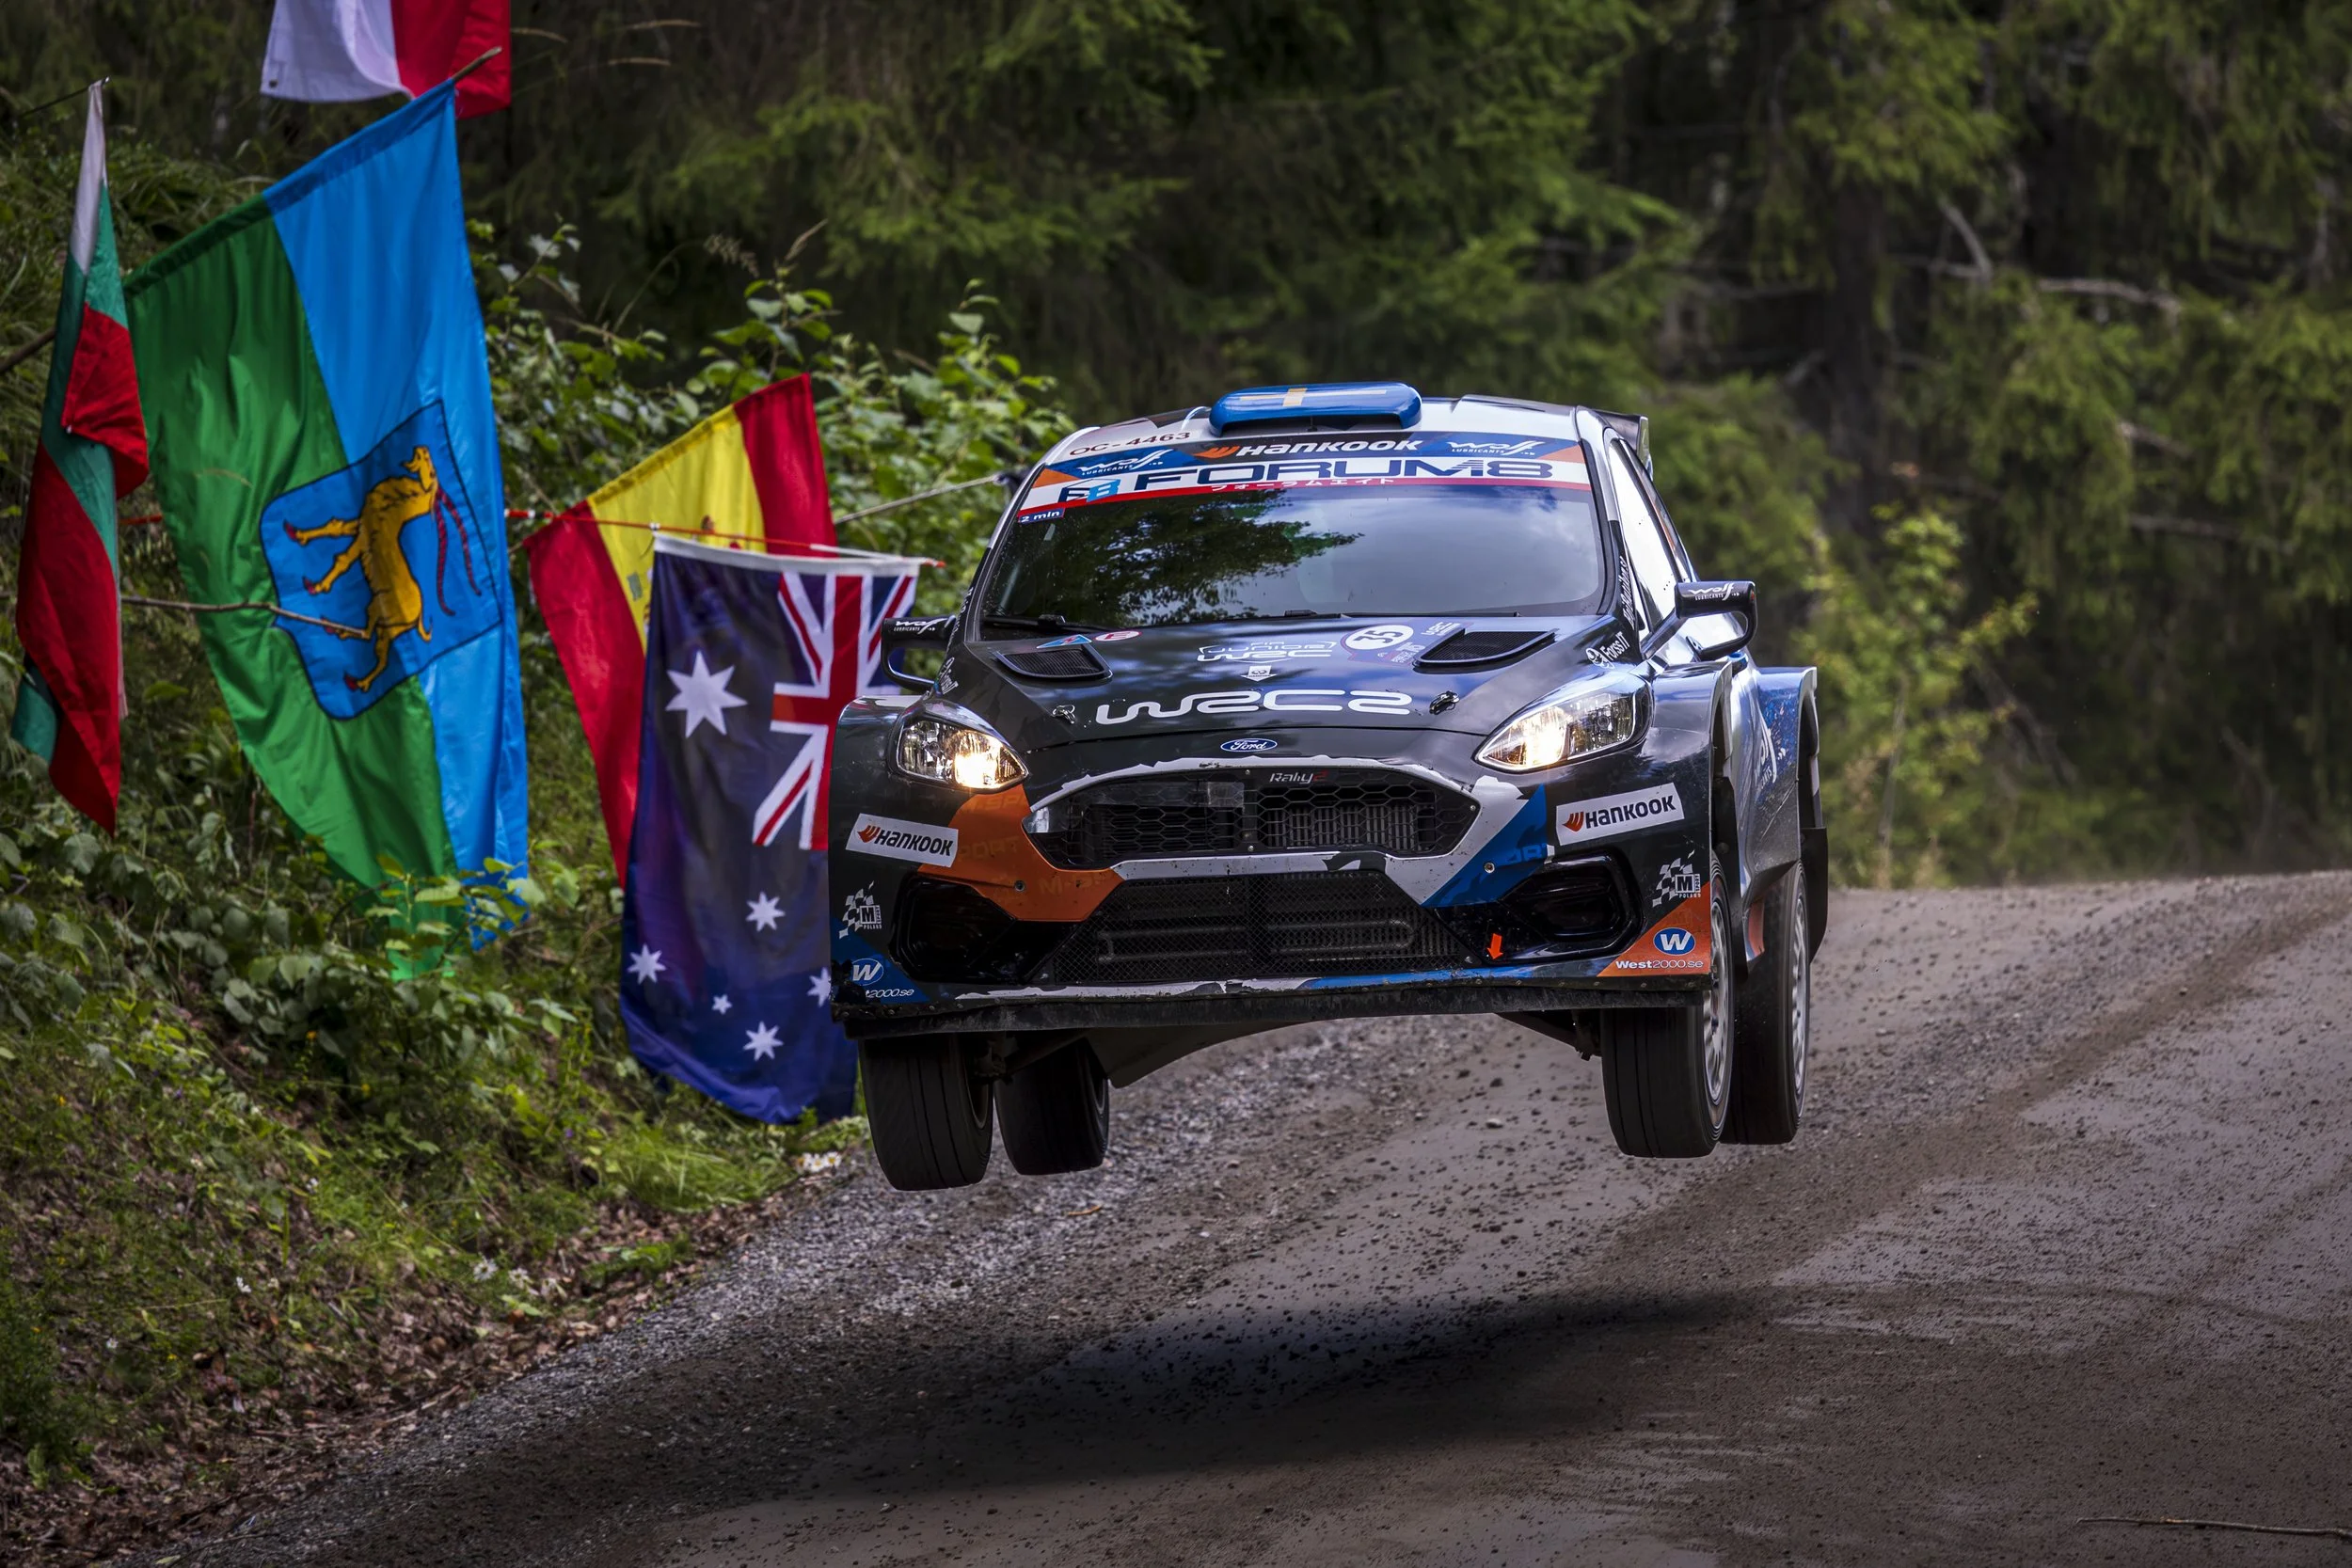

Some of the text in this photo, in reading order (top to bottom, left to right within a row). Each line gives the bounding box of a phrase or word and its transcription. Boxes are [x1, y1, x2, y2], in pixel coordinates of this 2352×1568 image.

[1134, 458, 1553, 492] FORUM8
[1033, 510, 1060, 520] min
[1353, 630, 1404, 644] 35
[1207, 642, 1326, 654] JUNIOR
[1197, 649, 1333, 662] WRC
[1096, 689, 1412, 725] WRC2
[1231, 739, 1267, 751] Ford
[1677, 876, 1693, 892] M
[862, 907, 876, 923] M
[1661, 931, 1692, 951] W
[852, 961, 882, 981] W
[1615, 959, 1704, 970] West2000.se
[866, 989, 914, 998] t2000.se
